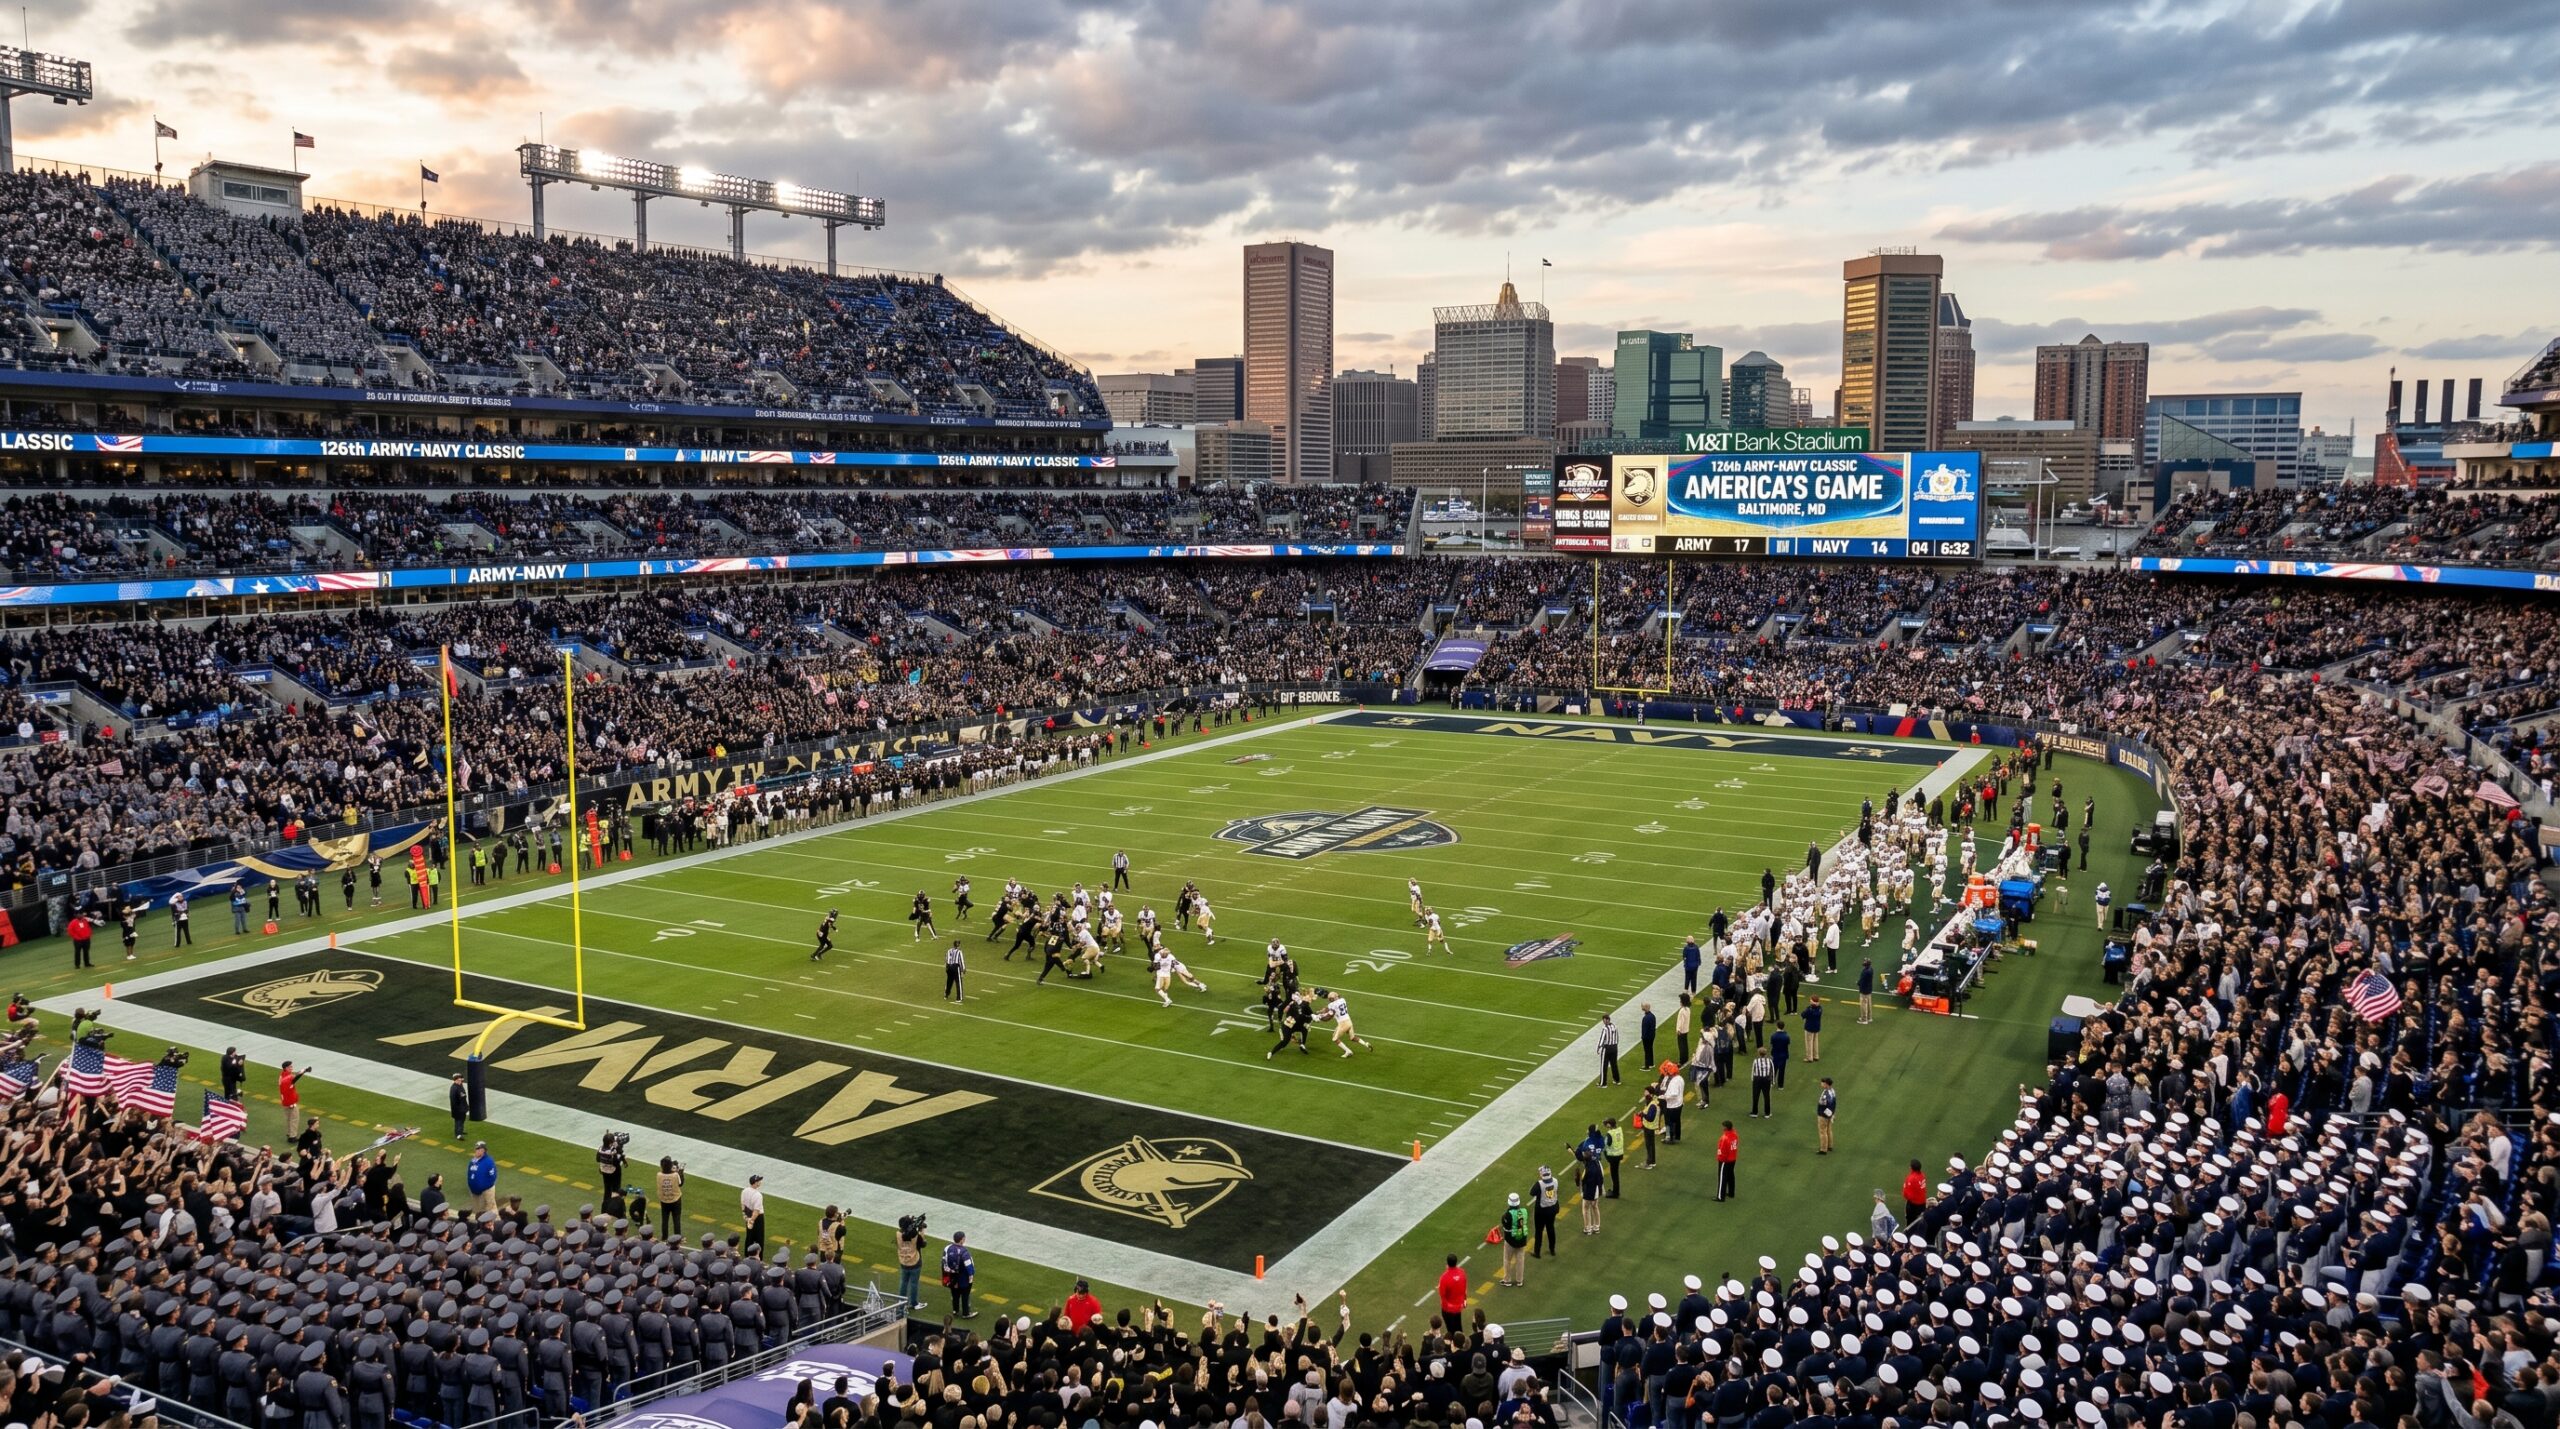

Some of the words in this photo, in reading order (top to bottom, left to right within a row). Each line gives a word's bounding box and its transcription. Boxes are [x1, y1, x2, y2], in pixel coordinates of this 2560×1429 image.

[320, 441, 365, 457] 126th
[369, 442, 462, 458] ARMY-NAVY
[465, 444, 525, 459] CLASSIC
[1685, 433, 1733, 451] M&T
[1735, 432, 1781, 451] Bank
[1784, 431, 1862, 450] Stadium
[938, 455, 966, 466] 126th
[969, 456, 1032, 467] ARMY-NAVY
[1034, 457, 1079, 467] CLASSIC
[1711, 460, 1741, 472] 126th
[1744, 460, 1808, 472] ARMY-NAVY
[1810, 460, 1858, 472] CLASSIC
[1684, 475, 1808, 500] AMERICA'S
[1815, 475, 1883, 500] GAME
[1738, 503, 1805, 517] BALTIMORE,
[1807, 503, 1826, 515] MD
[1675, 538, 1713, 551] ARMY
[1734, 538, 1750, 551] 17
[1812, 540, 1850, 553] NAVY
[1871, 541, 1888, 554] 14
[1911, 541, 1928, 555] Q4
[1940, 542, 1970, 555] 6:32
[468, 564, 567, 584] ARMY-NAVY
[1474, 723, 1775, 748] NAVY
[626, 767, 723, 812] ARMY
[1345, 949, 1413, 973] 20
[377, 1005, 998, 1146] ARMY
